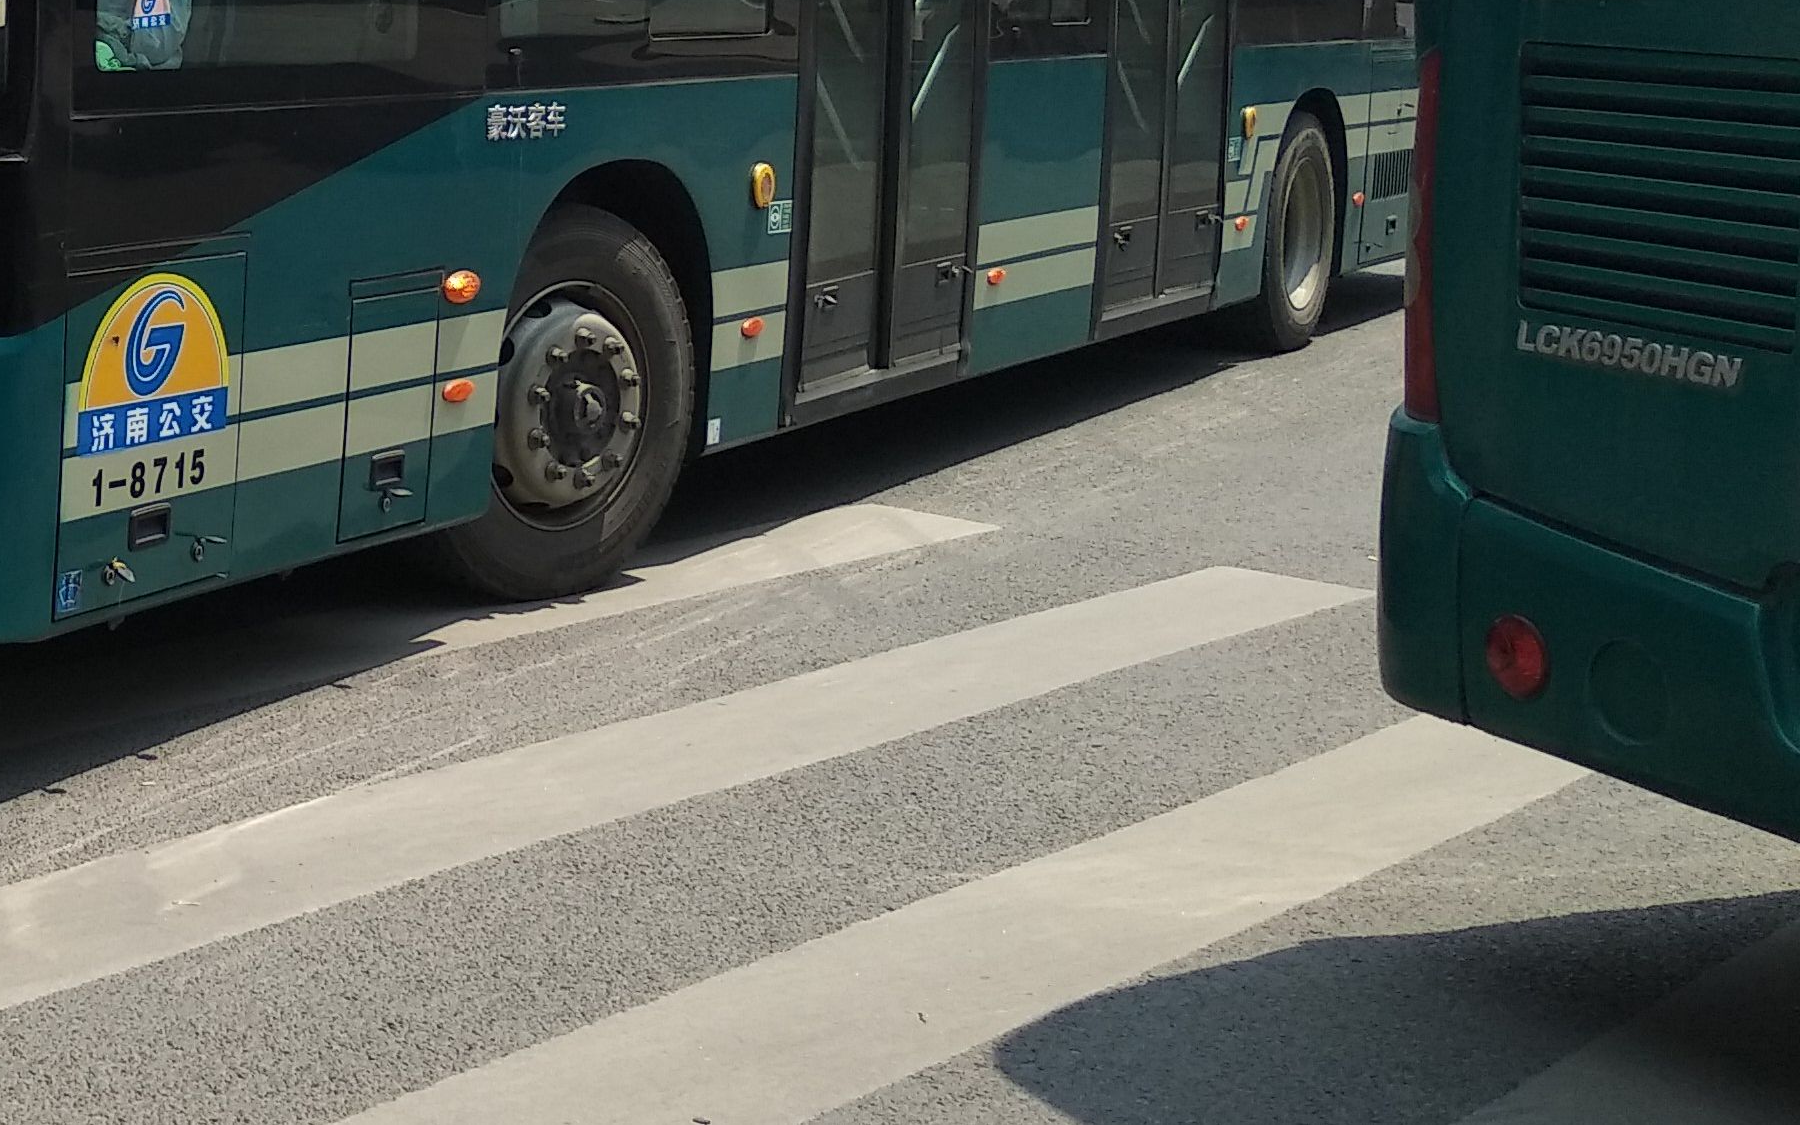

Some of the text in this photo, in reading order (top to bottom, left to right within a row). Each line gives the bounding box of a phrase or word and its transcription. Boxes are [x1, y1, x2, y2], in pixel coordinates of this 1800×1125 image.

[486, 102, 567, 141] 豪沃客车
[1516, 319, 1744, 388] LCK6950HGN
[91, 395, 214, 452] 济南公交
[92, 449, 206, 507] 1-8715
